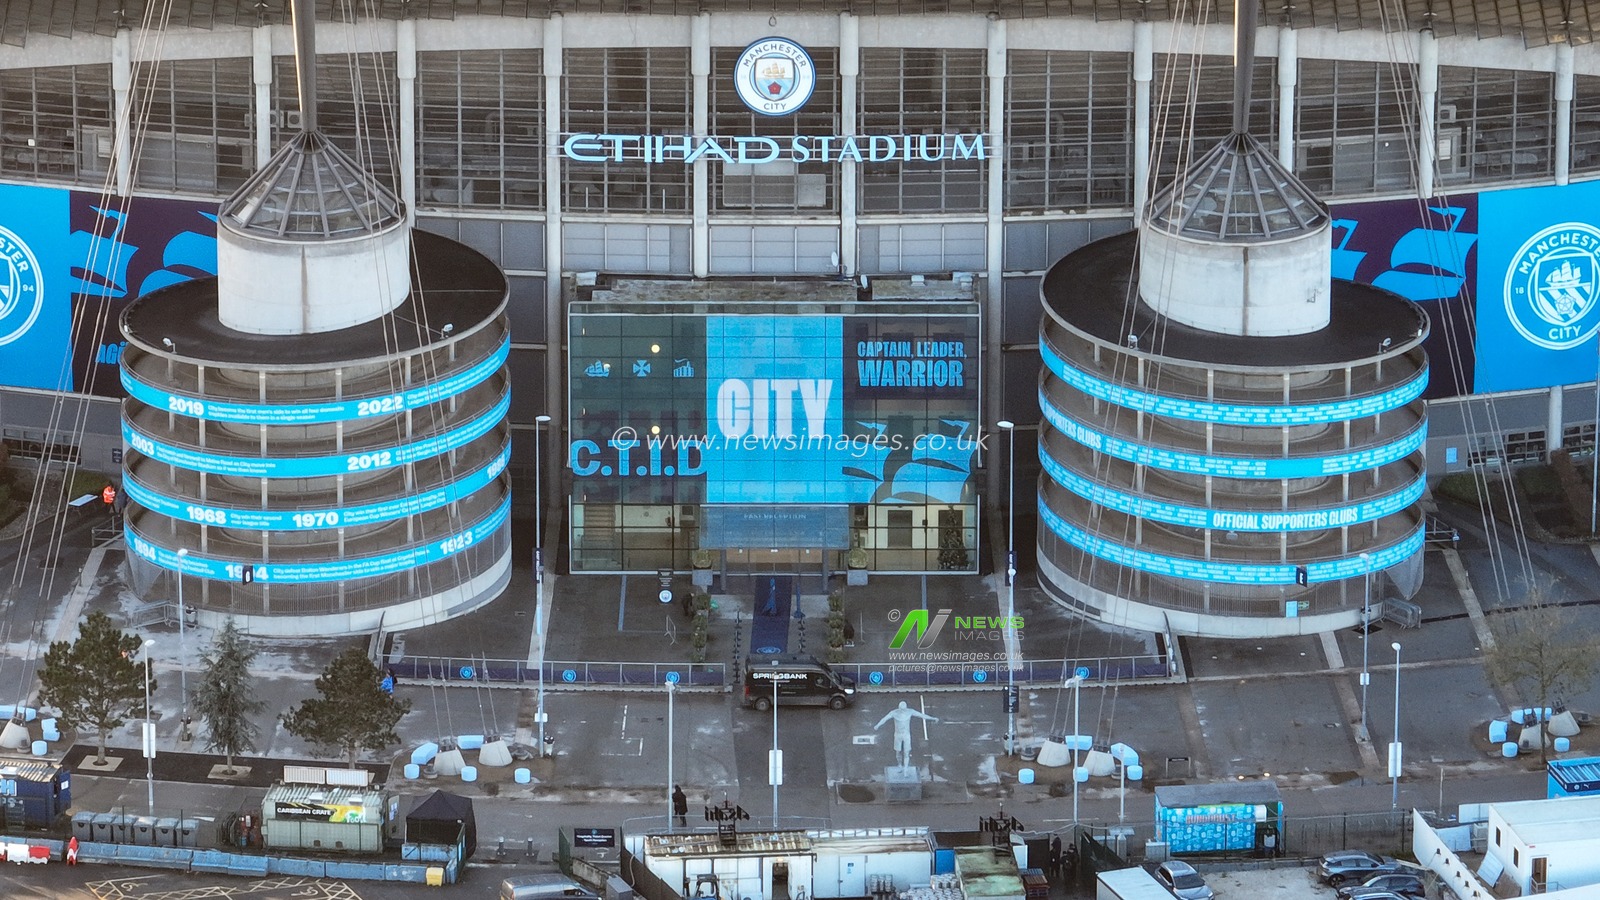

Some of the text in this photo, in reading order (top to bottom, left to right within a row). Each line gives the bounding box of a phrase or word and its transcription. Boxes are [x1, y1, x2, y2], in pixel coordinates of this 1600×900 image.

[743, 43, 807, 67] MANCHESTER
[563, 133, 986, 164] ETIHAD STADIUM
[22, 284, 34, 292] 94
[1548, 325, 1581, 340] CITY
[857, 341, 968, 359] CAPTAIN, LEADER,
[857, 360, 964, 387] WARRIOR
[168, 396, 205, 416] 2019
[357, 396, 404, 416] 2022
[716, 379, 833, 440] CITY
[131, 432, 155, 456] 2003
[1076, 426, 1102, 450] CLUBS
[347, 452, 392, 471] 2012
[186, 506, 226, 524] 1968
[292, 512, 339, 528] 1970
[1213, 508, 1358, 530] OFFICIAL SUPPORTERS CLUBS
[440, 531, 473, 555] 1923
[225, 564, 269, 581] 194
[753, 672, 807, 680] SPRIGBANK
[277, 807, 310, 815] CARIBBEAN
